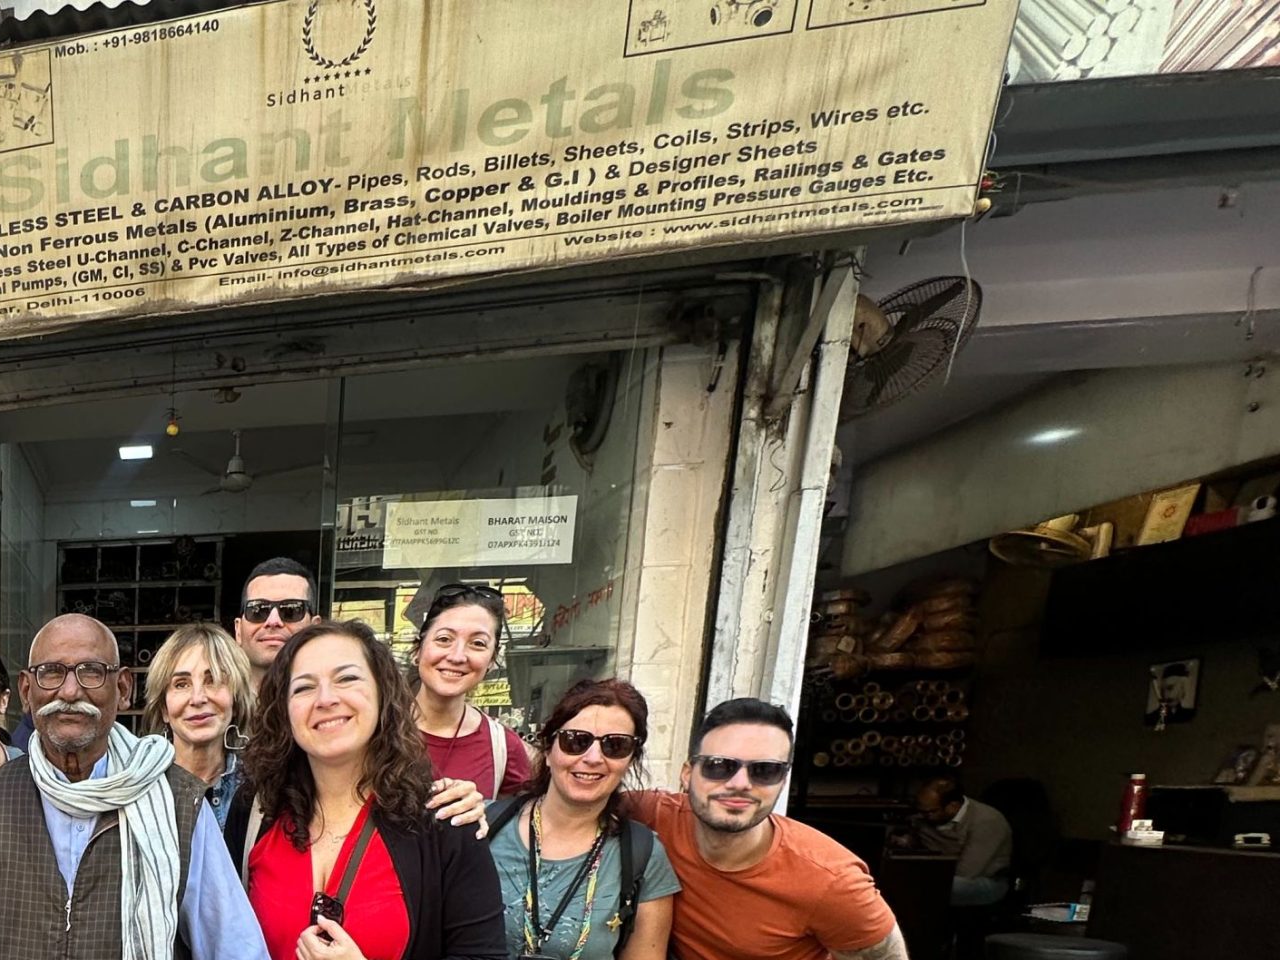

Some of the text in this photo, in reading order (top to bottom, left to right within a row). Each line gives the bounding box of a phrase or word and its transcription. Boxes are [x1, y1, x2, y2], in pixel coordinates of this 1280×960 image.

[55, 19, 220, 59] Mob. +91-9818664140
[266, 84, 346, 107] Sidhant
[386, 59, 737, 160] Metals
[55, 206, 123, 228] STEEL
[131, 202, 146, 217] &
[154, 188, 249, 214] CARBON
[348, 173, 409, 192] Pipes,
[416, 162, 476, 182] Rods,
[484, 151, 556, 173] Billets,
[563, 140, 644, 163] Sheets,
[653, 128, 718, 150] Coils,
[726, 118, 800, 139] Strips,
[810, 107, 878, 129] Wires
[886, 101, 929, 119] etc.
[27, 255, 70, 273] Steel
[77, 243, 171, 267] U-Channel,
[177, 231, 274, 254] C-Channel,
[280, 218, 380, 242] Z-Channel,
[387, 202, 514, 229] Hat-Channel,
[521, 186, 626, 212] Mouldings
[634, 183, 649, 197] &
[657, 173, 746, 195] Profiles,
[754, 159, 844, 183] Railings
[852, 154, 869, 170] &
[877, 147, 946, 167] Gates
[40, 230, 119, 251] Ferrous
[126, 218, 197, 240] Metals
[204, 204, 336, 233] (Aluminium,
[344, 195, 416, 214] Brass,
[425, 181, 510, 204] Copper
[517, 176, 535, 192] &
[605, 164, 621, 180] &
[629, 151, 731, 177] Designer
[736, 140, 818, 163] Sheets
[12, 274, 67, 293] Pumps,
[72, 269, 107, 287] (GM,
[112, 265, 133, 280] CI,
[139, 262, 165, 276] SS)
[171, 259, 183, 272] &
[189, 257, 218, 270] Pvc
[223, 250, 283, 267] Valves,
[287, 244, 309, 259] All
[315, 237, 367, 258] Types
[372, 234, 389, 249] of
[394, 223, 477, 246] Chemical
[483, 217, 550, 236] Valves,
[556, 207, 612, 226] Boiler
[617, 197, 706, 219] Mounting
[713, 184, 802, 206] Pressure
[808, 174, 886, 194] Gauges
[892, 167, 933, 184] Etc.
[564, 230, 643, 246] Website
[663, 196, 923, 235] www.sidhantmetals.com
[219, 246, 505, 286] Email- info@sidhantmetals.com
[27, 287, 146, 310] Delhi-110006
[396, 517, 460, 526] Sidhant Metals
[488, 515, 568, 526] BHARAT MAISON
